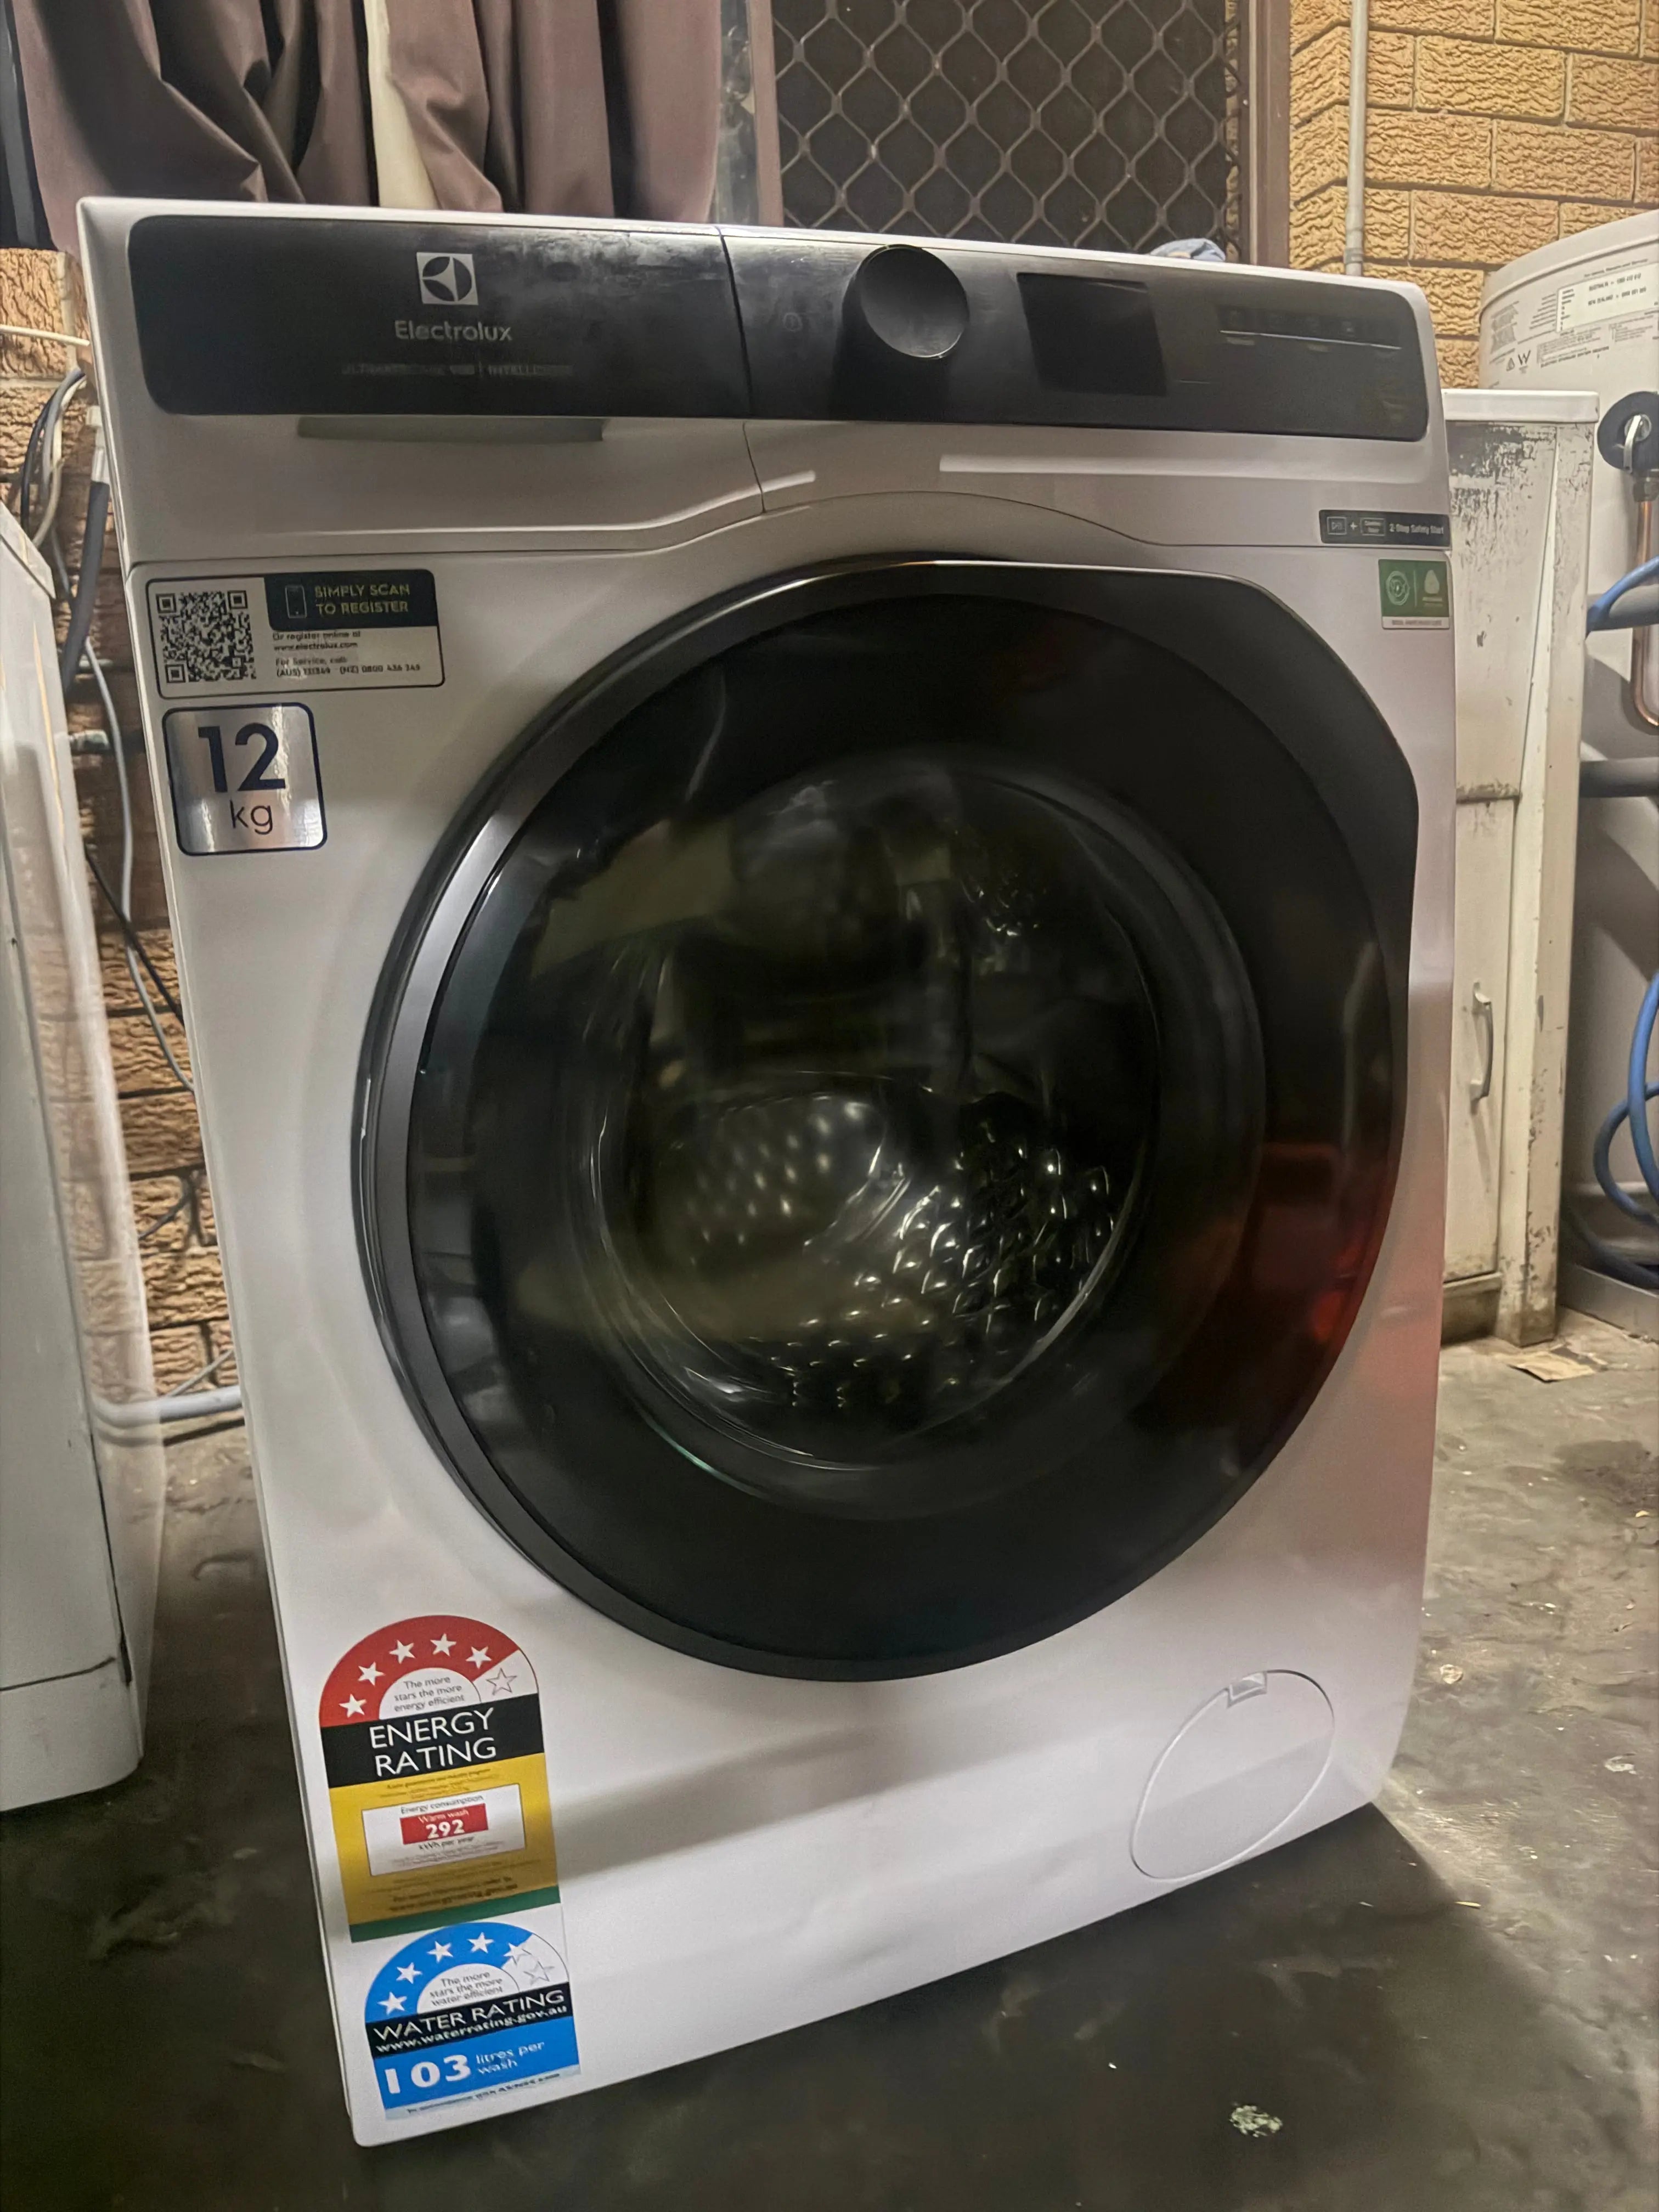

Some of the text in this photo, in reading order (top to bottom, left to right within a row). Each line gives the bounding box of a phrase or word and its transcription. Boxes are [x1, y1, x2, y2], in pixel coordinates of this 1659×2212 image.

[394, 320, 512, 341] Electrolux
[315, 584, 410, 598] SIMPLY SCAN
[315, 601, 409, 615] TO REGISTER
[286, 632, 320, 641] register
[274, 642, 358, 651] www.electrolux.com
[276, 667, 301, 677] (AUS)
[198, 723, 286, 793] 12
[229, 800, 273, 835] kg
[394, 1685, 462, 1701] stars the more
[403, 1677, 451, 1690] The more
[394, 1694, 465, 1712] energy efficient
[369, 1707, 494, 1748] ENERGY
[375, 1737, 496, 1777] RATING
[400, 1795, 484, 1814] Energy consumption
[417, 1813, 447, 1824] Warm
[425, 1819, 465, 1839] 292
[430, 1978, 503, 1997] stars the more
[441, 1972, 490, 1987] The more
[431, 1986, 503, 2006] water efficient
[373, 1989, 565, 2041] WATER RATING
[375, 2005, 567, 2052] www.waterrating.gov.au
[384, 2041, 545, 2095] 103 litres per
[478, 2059, 518, 2075] wash
